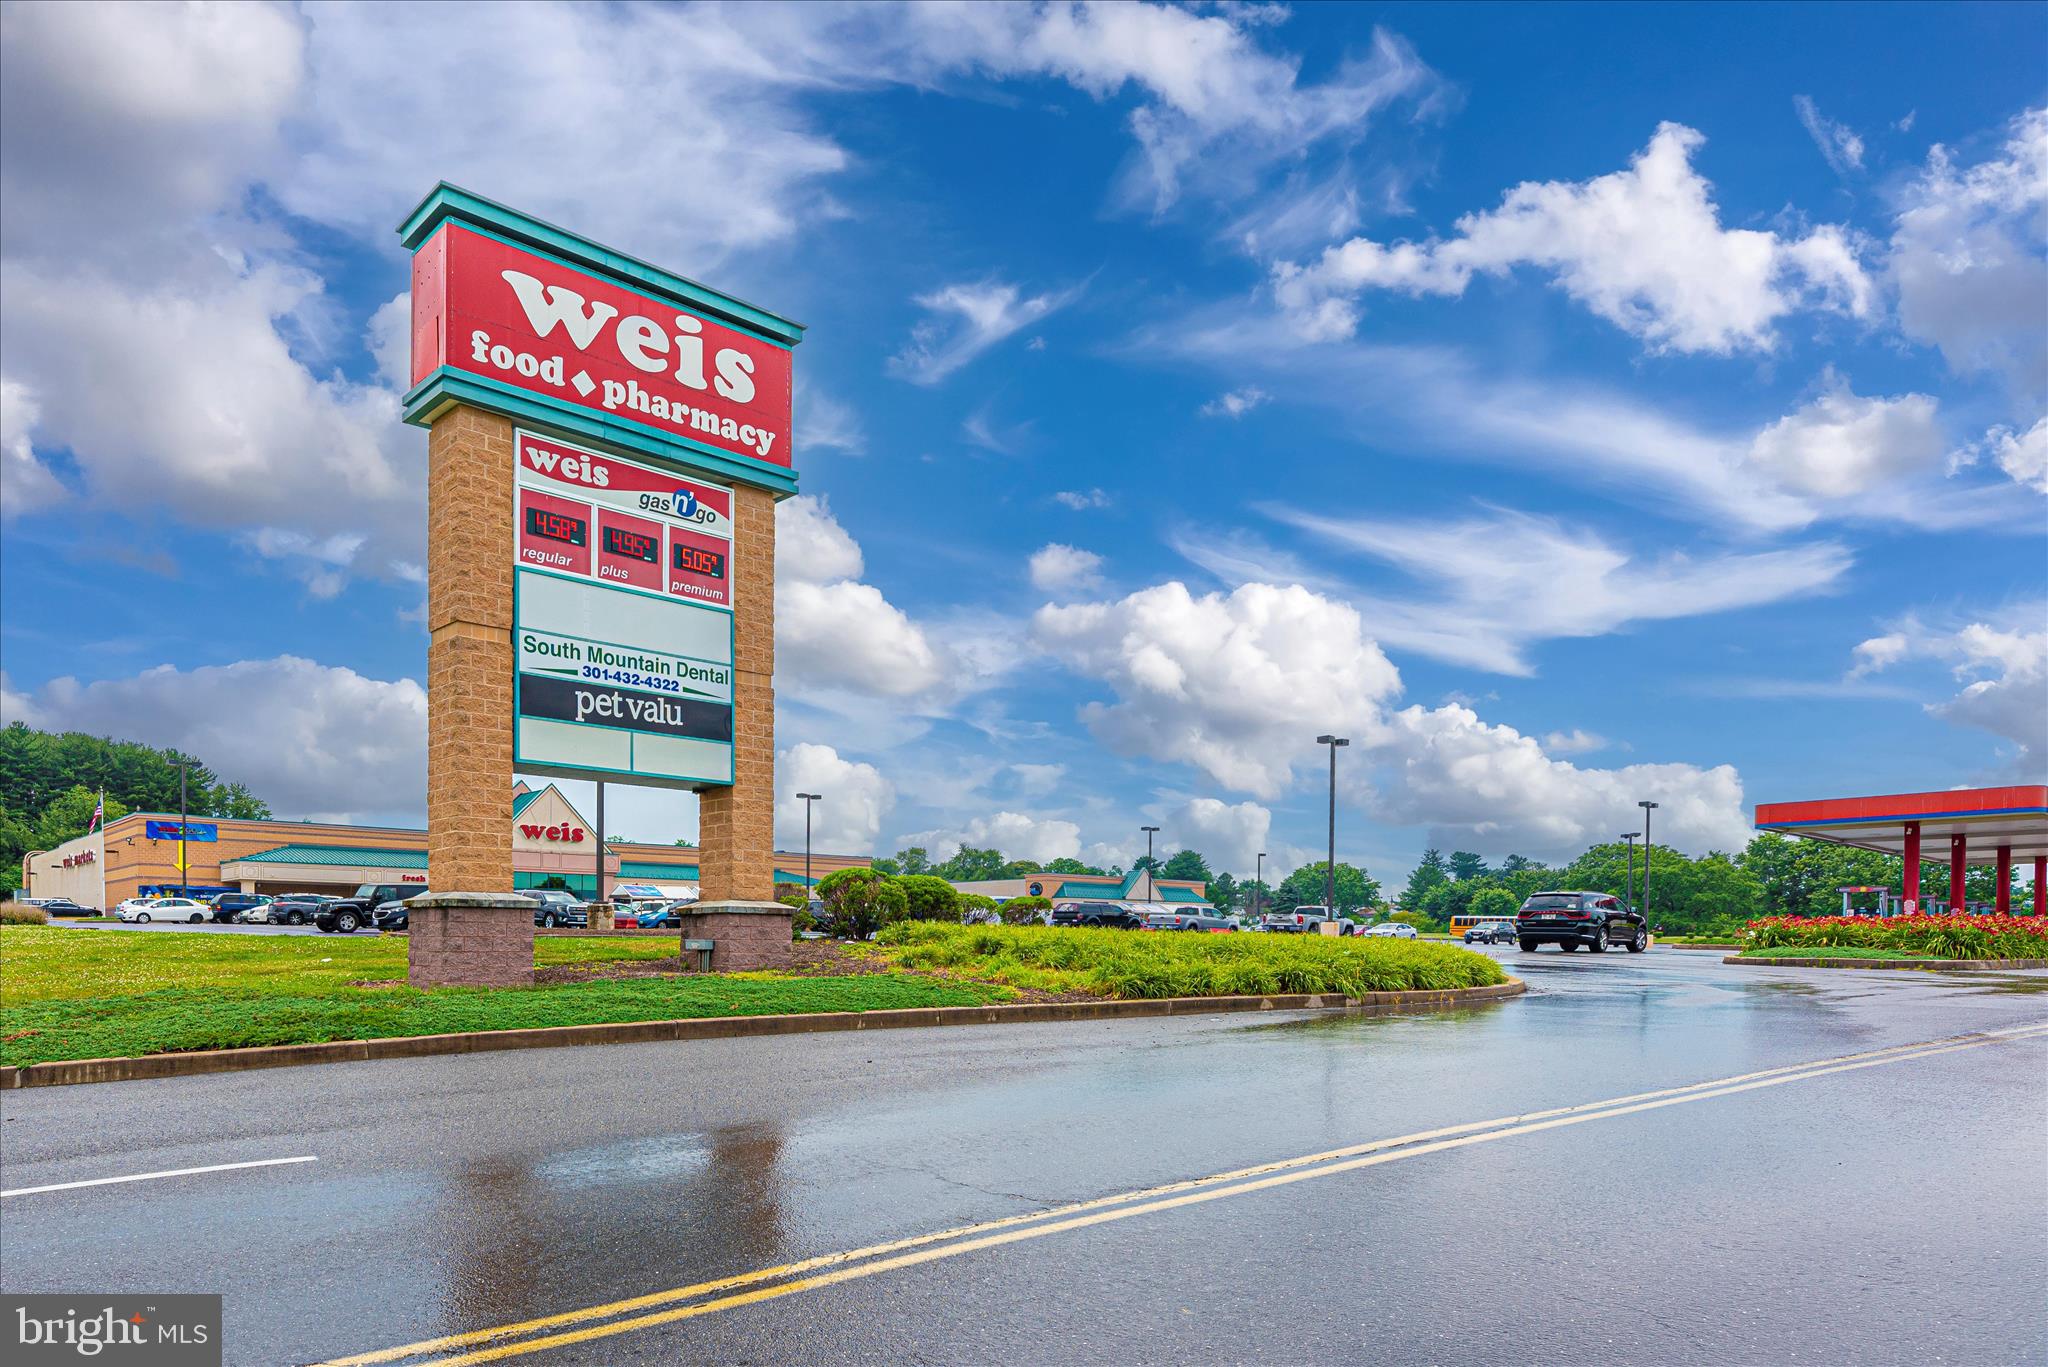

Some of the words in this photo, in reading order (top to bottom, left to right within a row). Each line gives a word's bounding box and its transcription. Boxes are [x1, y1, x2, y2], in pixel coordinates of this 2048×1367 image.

[501, 270, 755, 404] weis
[470, 330, 565, 388] food
[602, 379, 776, 456] pharmacy
[525, 447, 609, 487] weis
[639, 493, 670, 511] gas
[696, 508, 716, 524] go
[522, 547, 573, 567] regular
[600, 564, 629, 580] plus
[671, 580, 724, 600] premium
[523, 635, 580, 660] South
[587, 646, 670, 675] Mountain
[677, 661, 729, 685] Dental
[583, 666, 679, 692] 301-432-4322
[575, 690, 623, 722] pet
[625, 697, 684, 726] valu
[519, 822, 584, 842] weis
